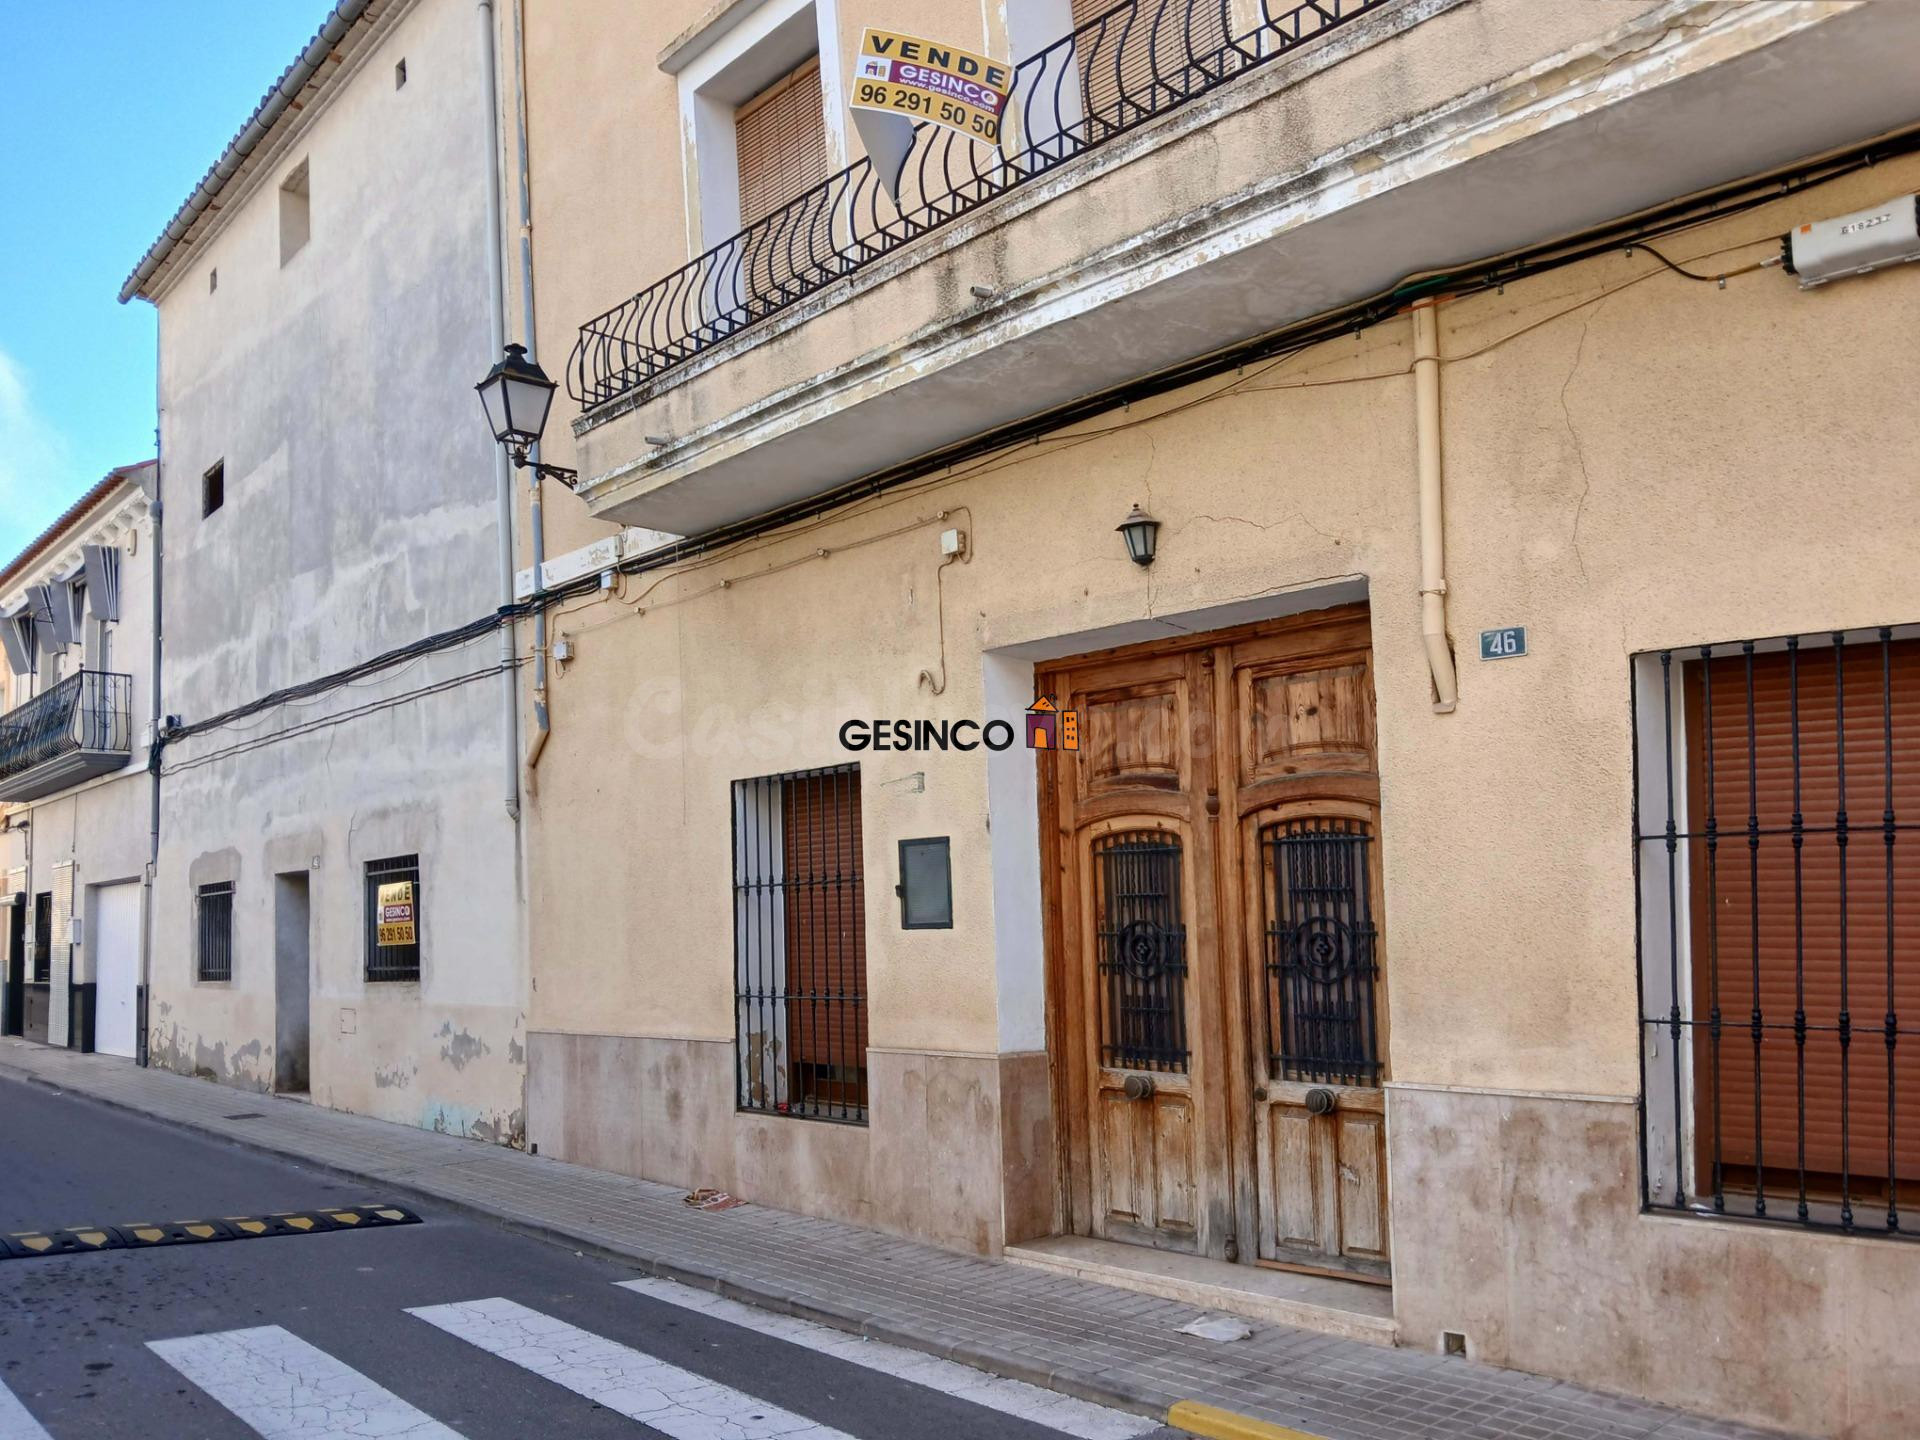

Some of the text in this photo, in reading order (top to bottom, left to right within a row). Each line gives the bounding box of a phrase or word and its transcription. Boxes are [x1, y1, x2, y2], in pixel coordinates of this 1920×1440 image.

[871, 35, 1006, 89] VENDE
[898, 77, 996, 114] www.gesinco.com
[899, 65, 999, 106] GESINCO
[860, 84, 997, 139] 96 291 50 50
[1489, 630, 1517, 654] 46
